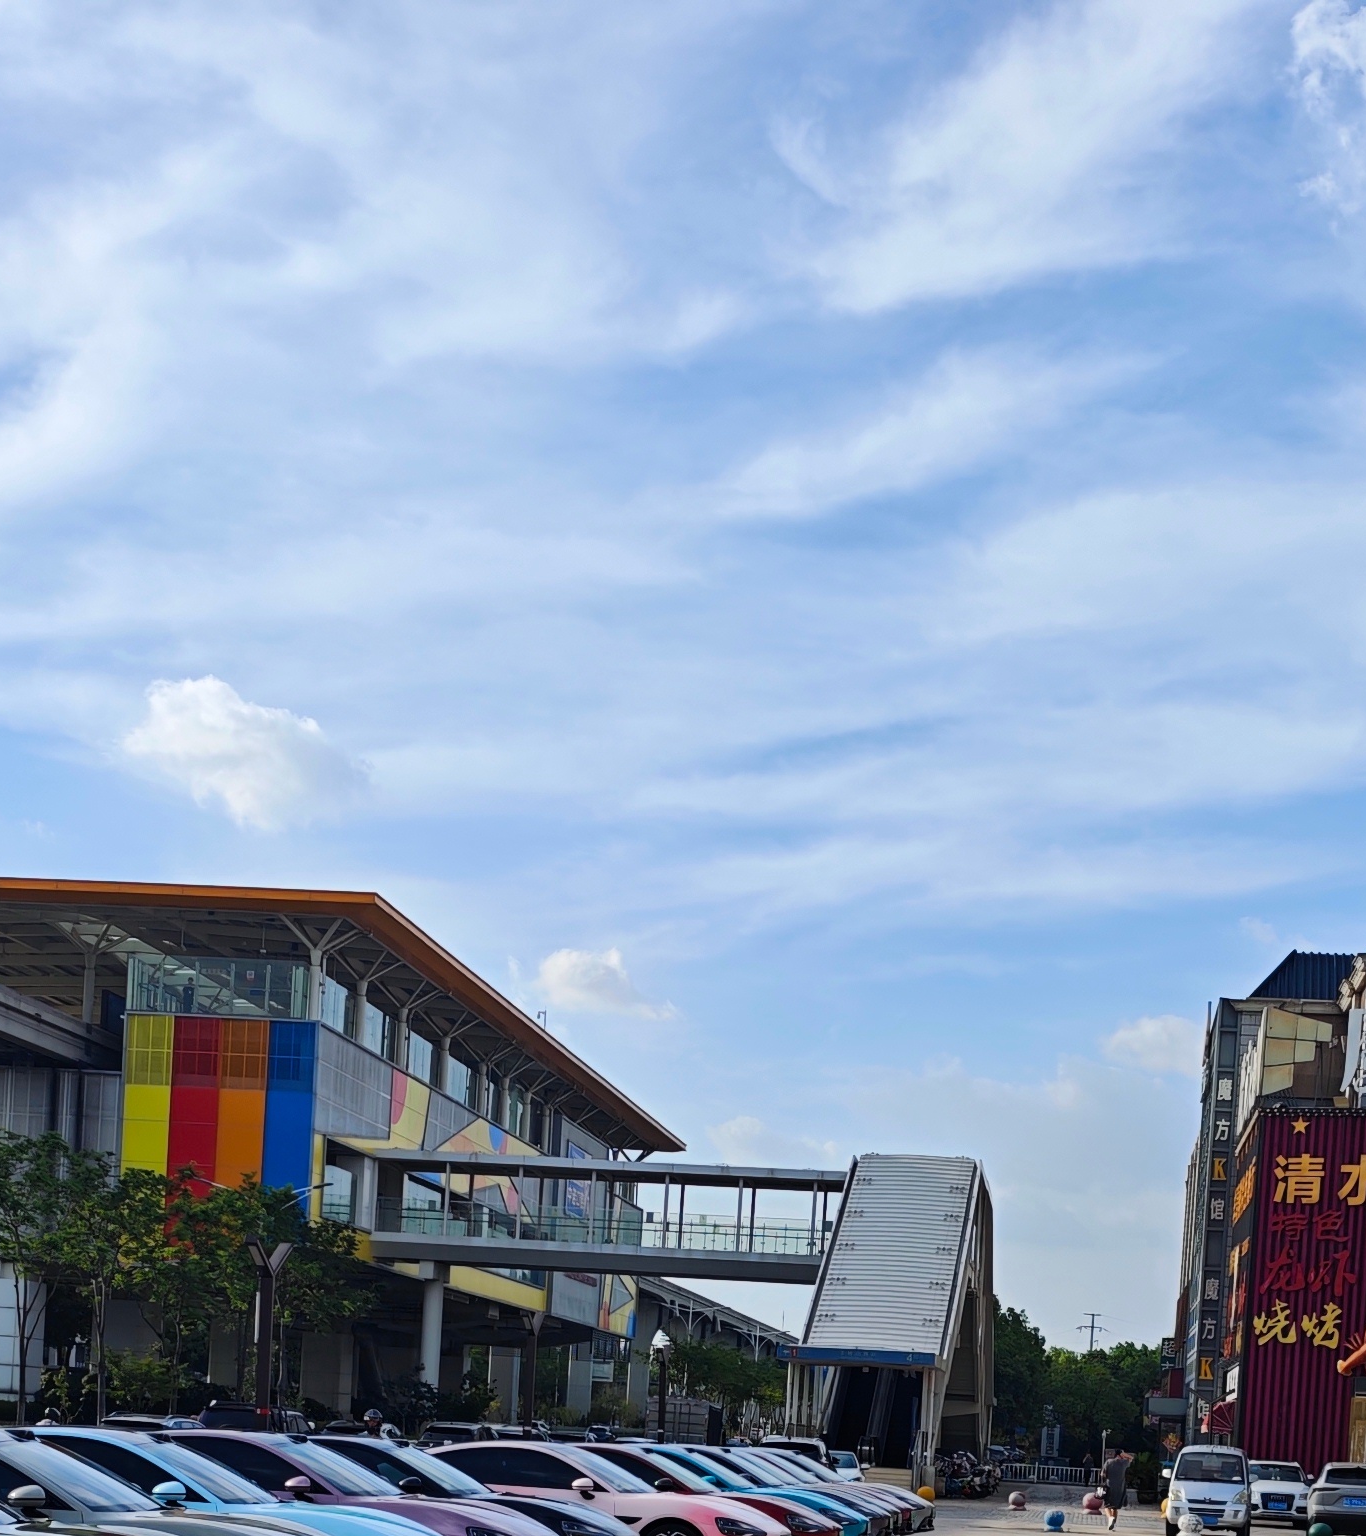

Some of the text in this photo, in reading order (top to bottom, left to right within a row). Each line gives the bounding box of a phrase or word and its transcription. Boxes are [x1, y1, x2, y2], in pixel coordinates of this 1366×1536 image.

[1269, 1208, 1352, 1243] 特色
[1259, 1244, 1356, 1297] 龙虾
[1253, 1298, 1343, 1350] 烧烤
